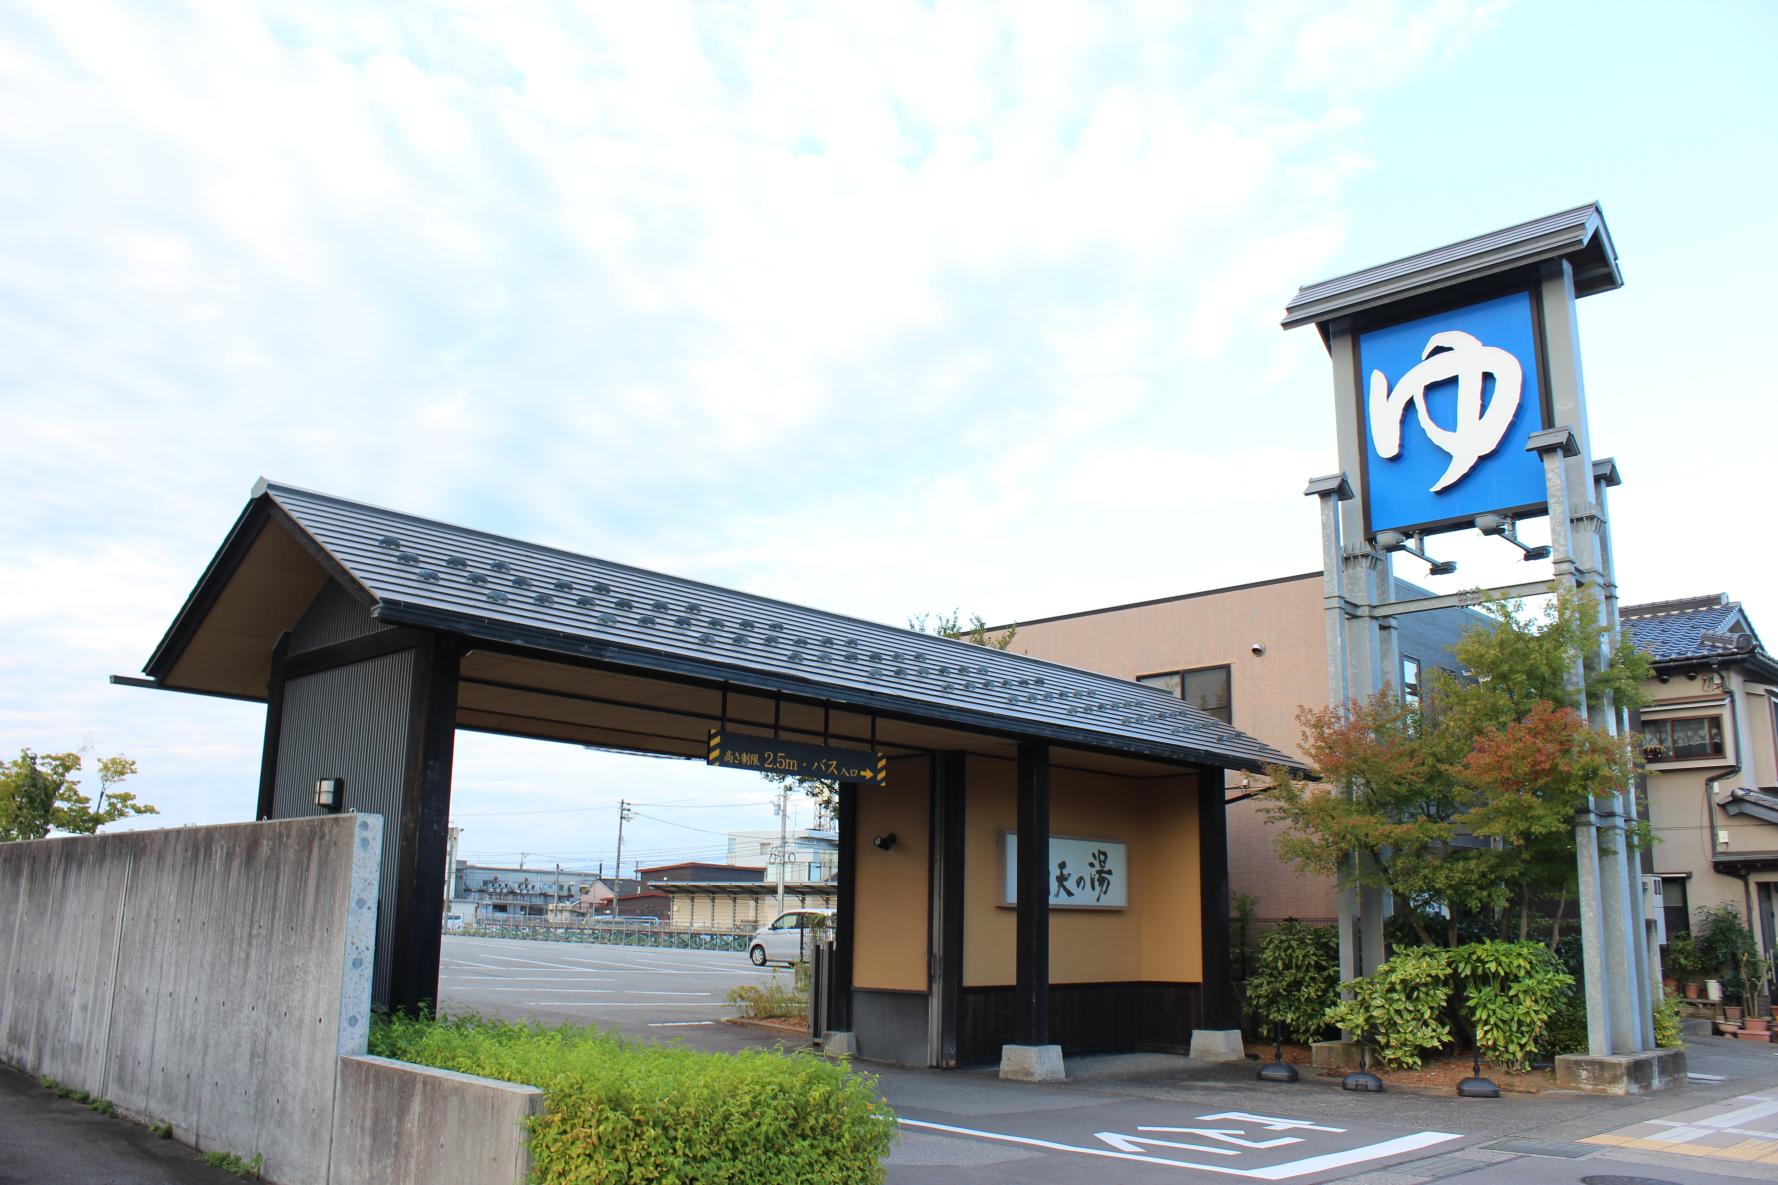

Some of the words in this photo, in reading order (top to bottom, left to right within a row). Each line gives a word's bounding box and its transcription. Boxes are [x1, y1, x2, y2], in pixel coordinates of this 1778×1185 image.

[1370, 331, 1522, 492] ゆ
[1048, 849, 1113, 903] 天の湯
